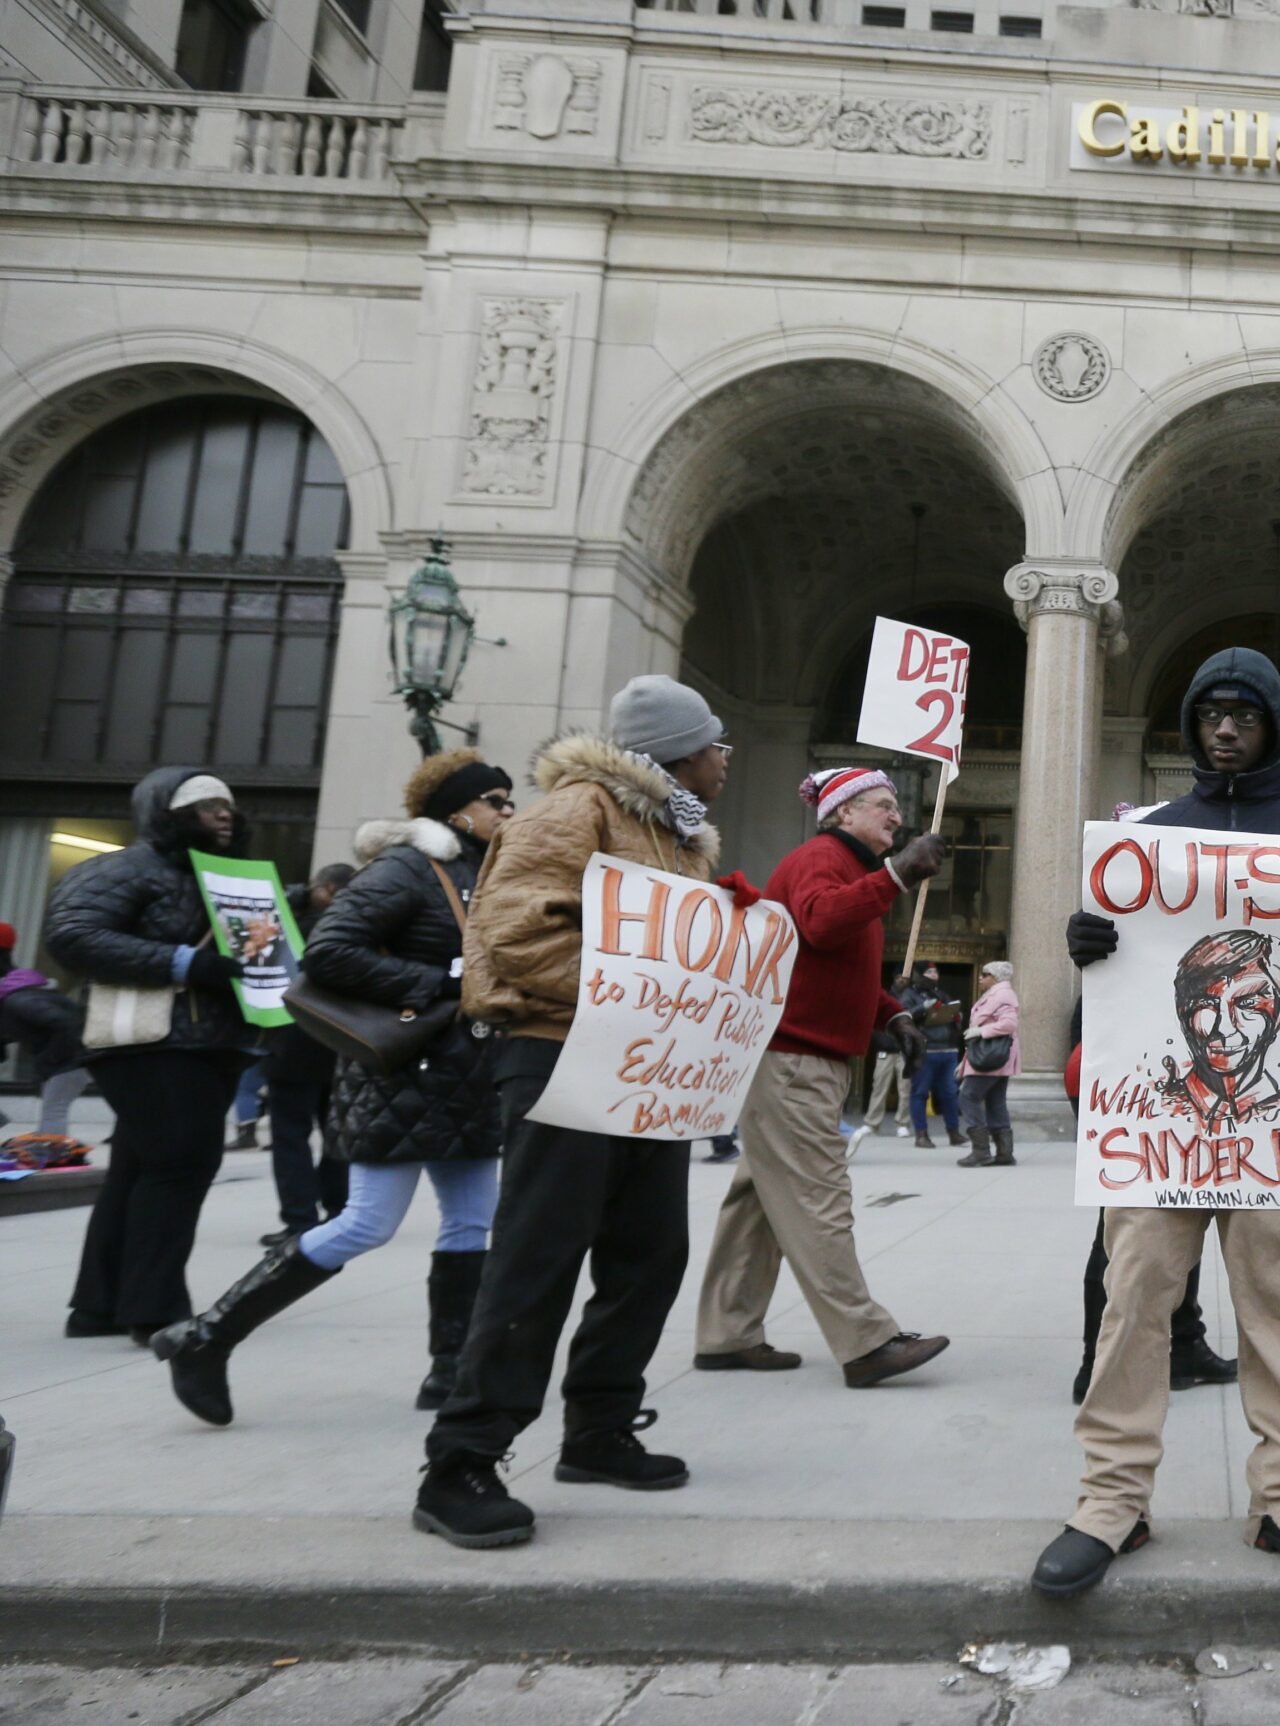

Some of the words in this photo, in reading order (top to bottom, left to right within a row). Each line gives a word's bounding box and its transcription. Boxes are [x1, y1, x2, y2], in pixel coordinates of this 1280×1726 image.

[595, 864, 796, 1005] HONK
[586, 967, 625, 1006] to
[631, 971, 718, 1033] Defed
[1090, 1073, 1164, 1120] With
